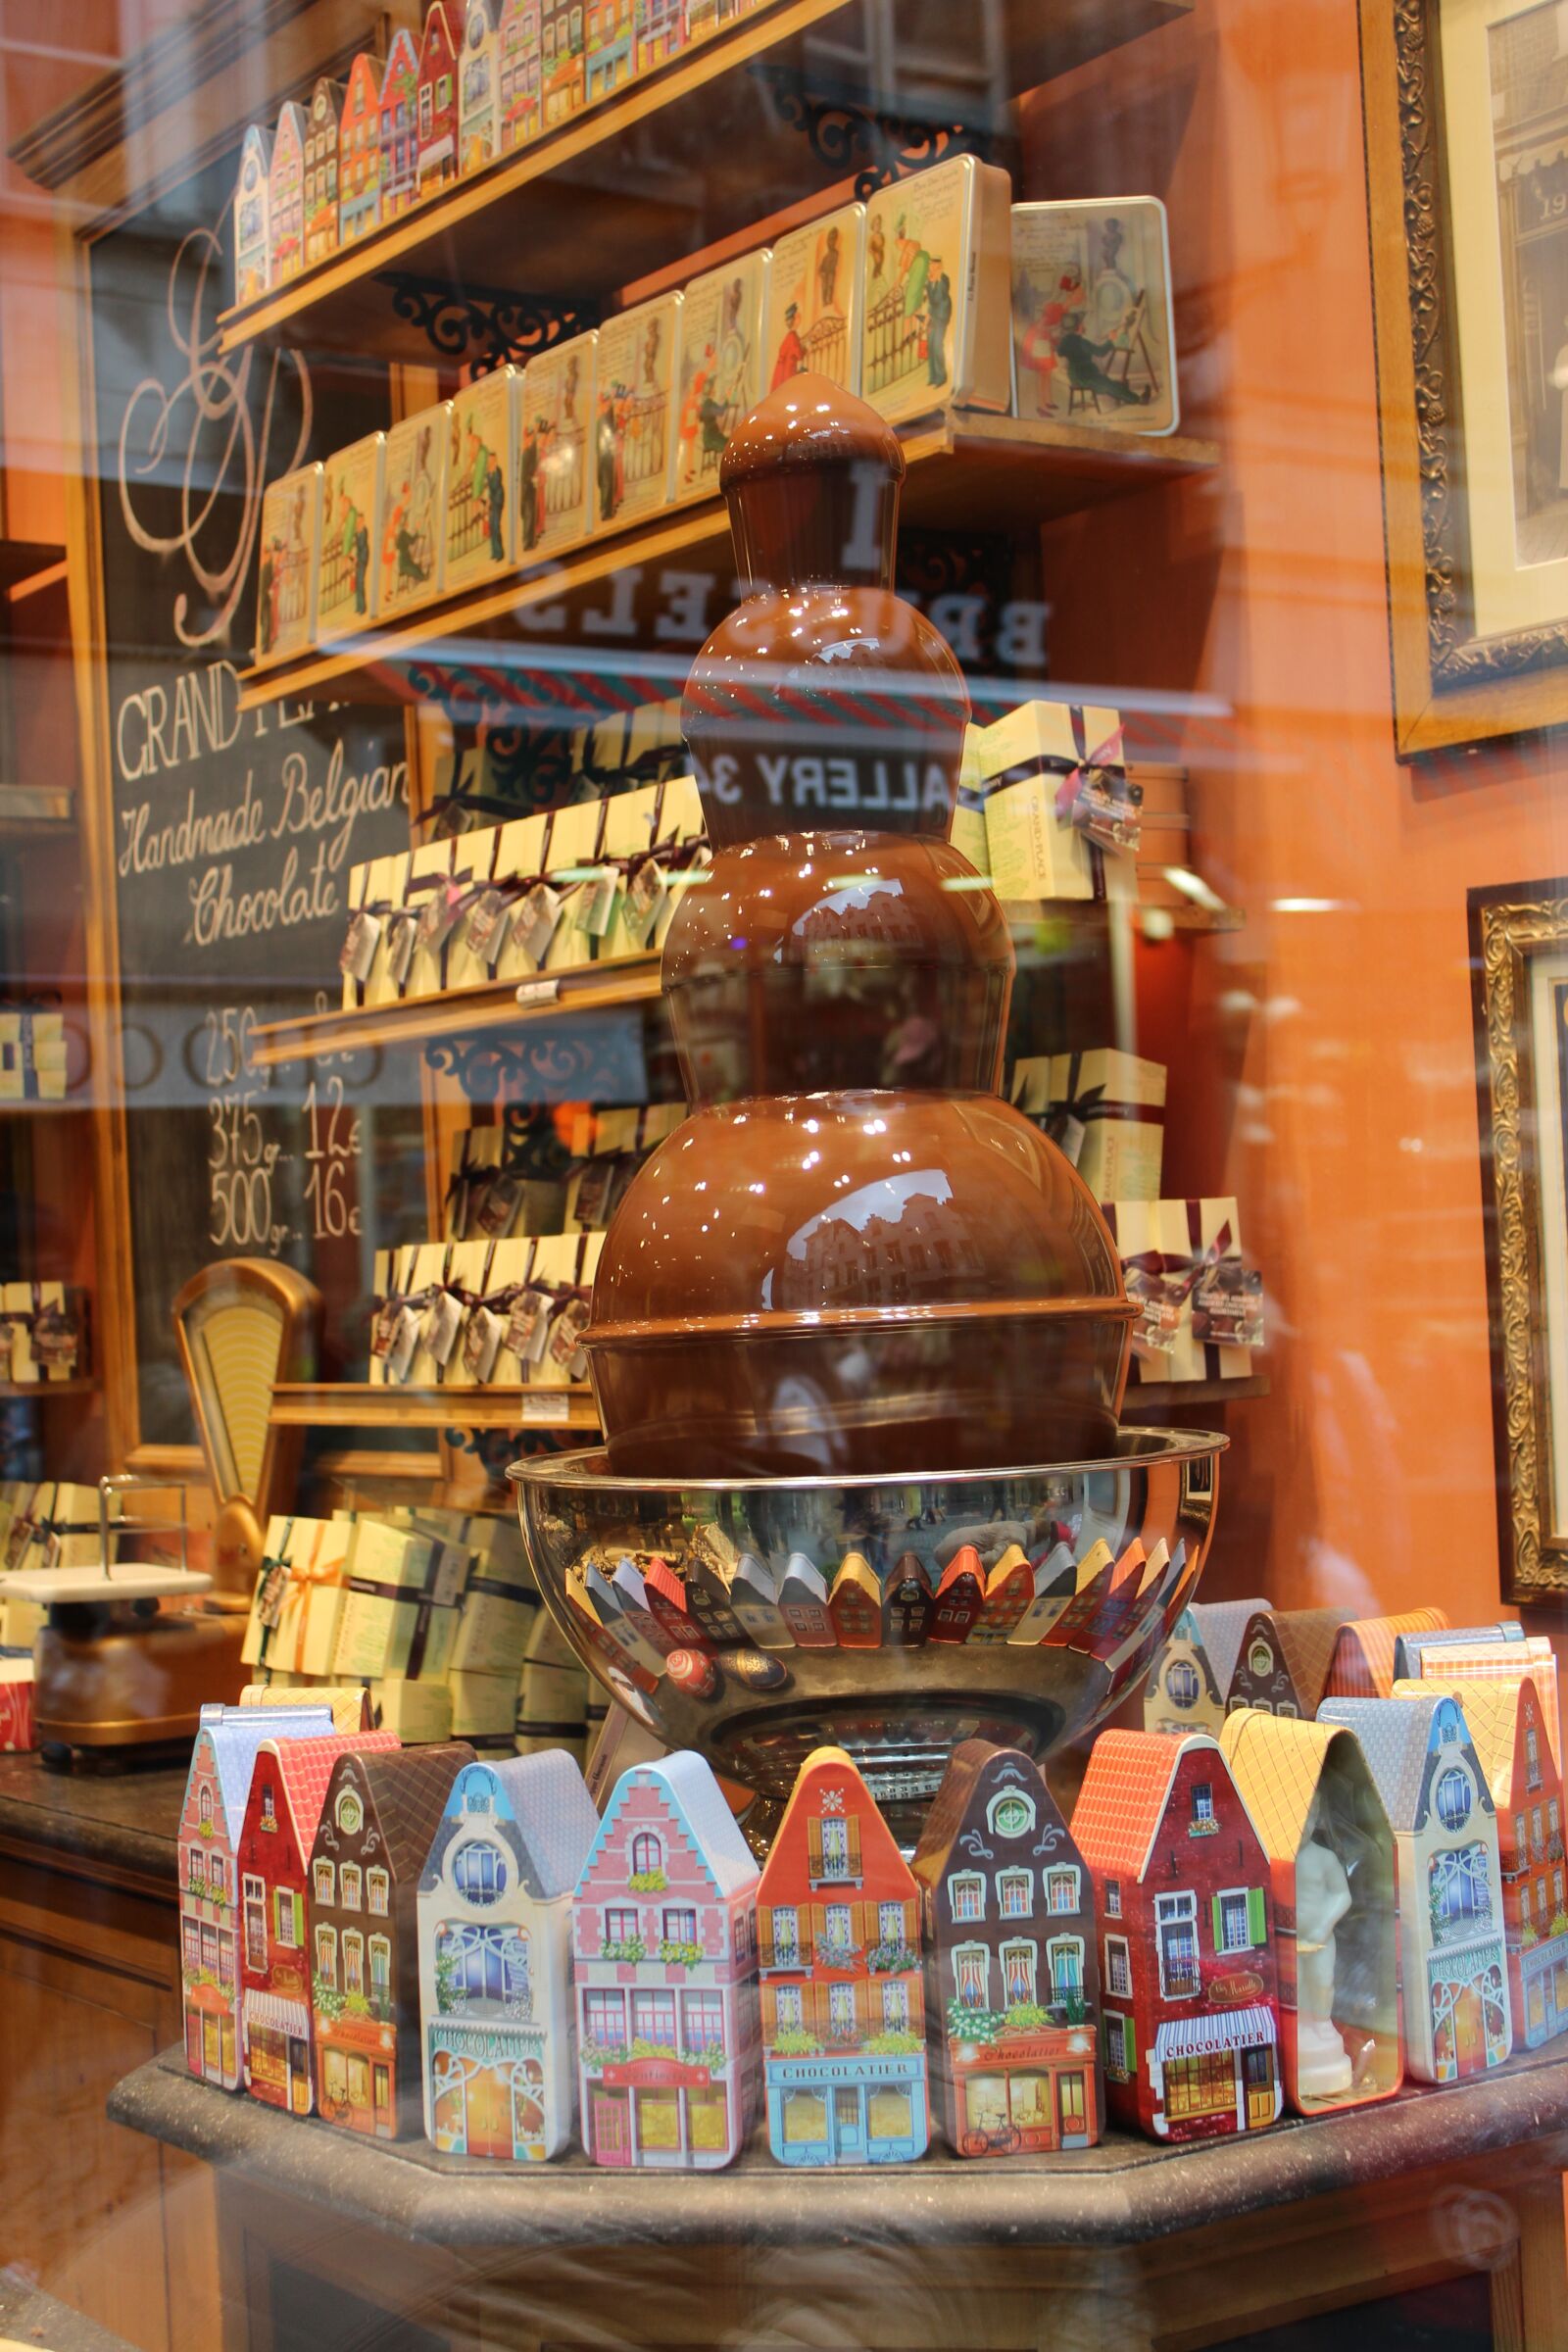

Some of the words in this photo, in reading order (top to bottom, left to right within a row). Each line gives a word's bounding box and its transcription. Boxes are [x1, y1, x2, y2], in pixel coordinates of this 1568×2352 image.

[117, 660, 243, 781] GRAND
[119, 769, 266, 878] Handmade
[270, 738, 411, 873] Belgian
[184, 840, 340, 947] Chocolate
[782, 2063, 907, 2079] CHOCOLATIER
[1166, 2031, 1265, 2058] CHOCOLATIER
